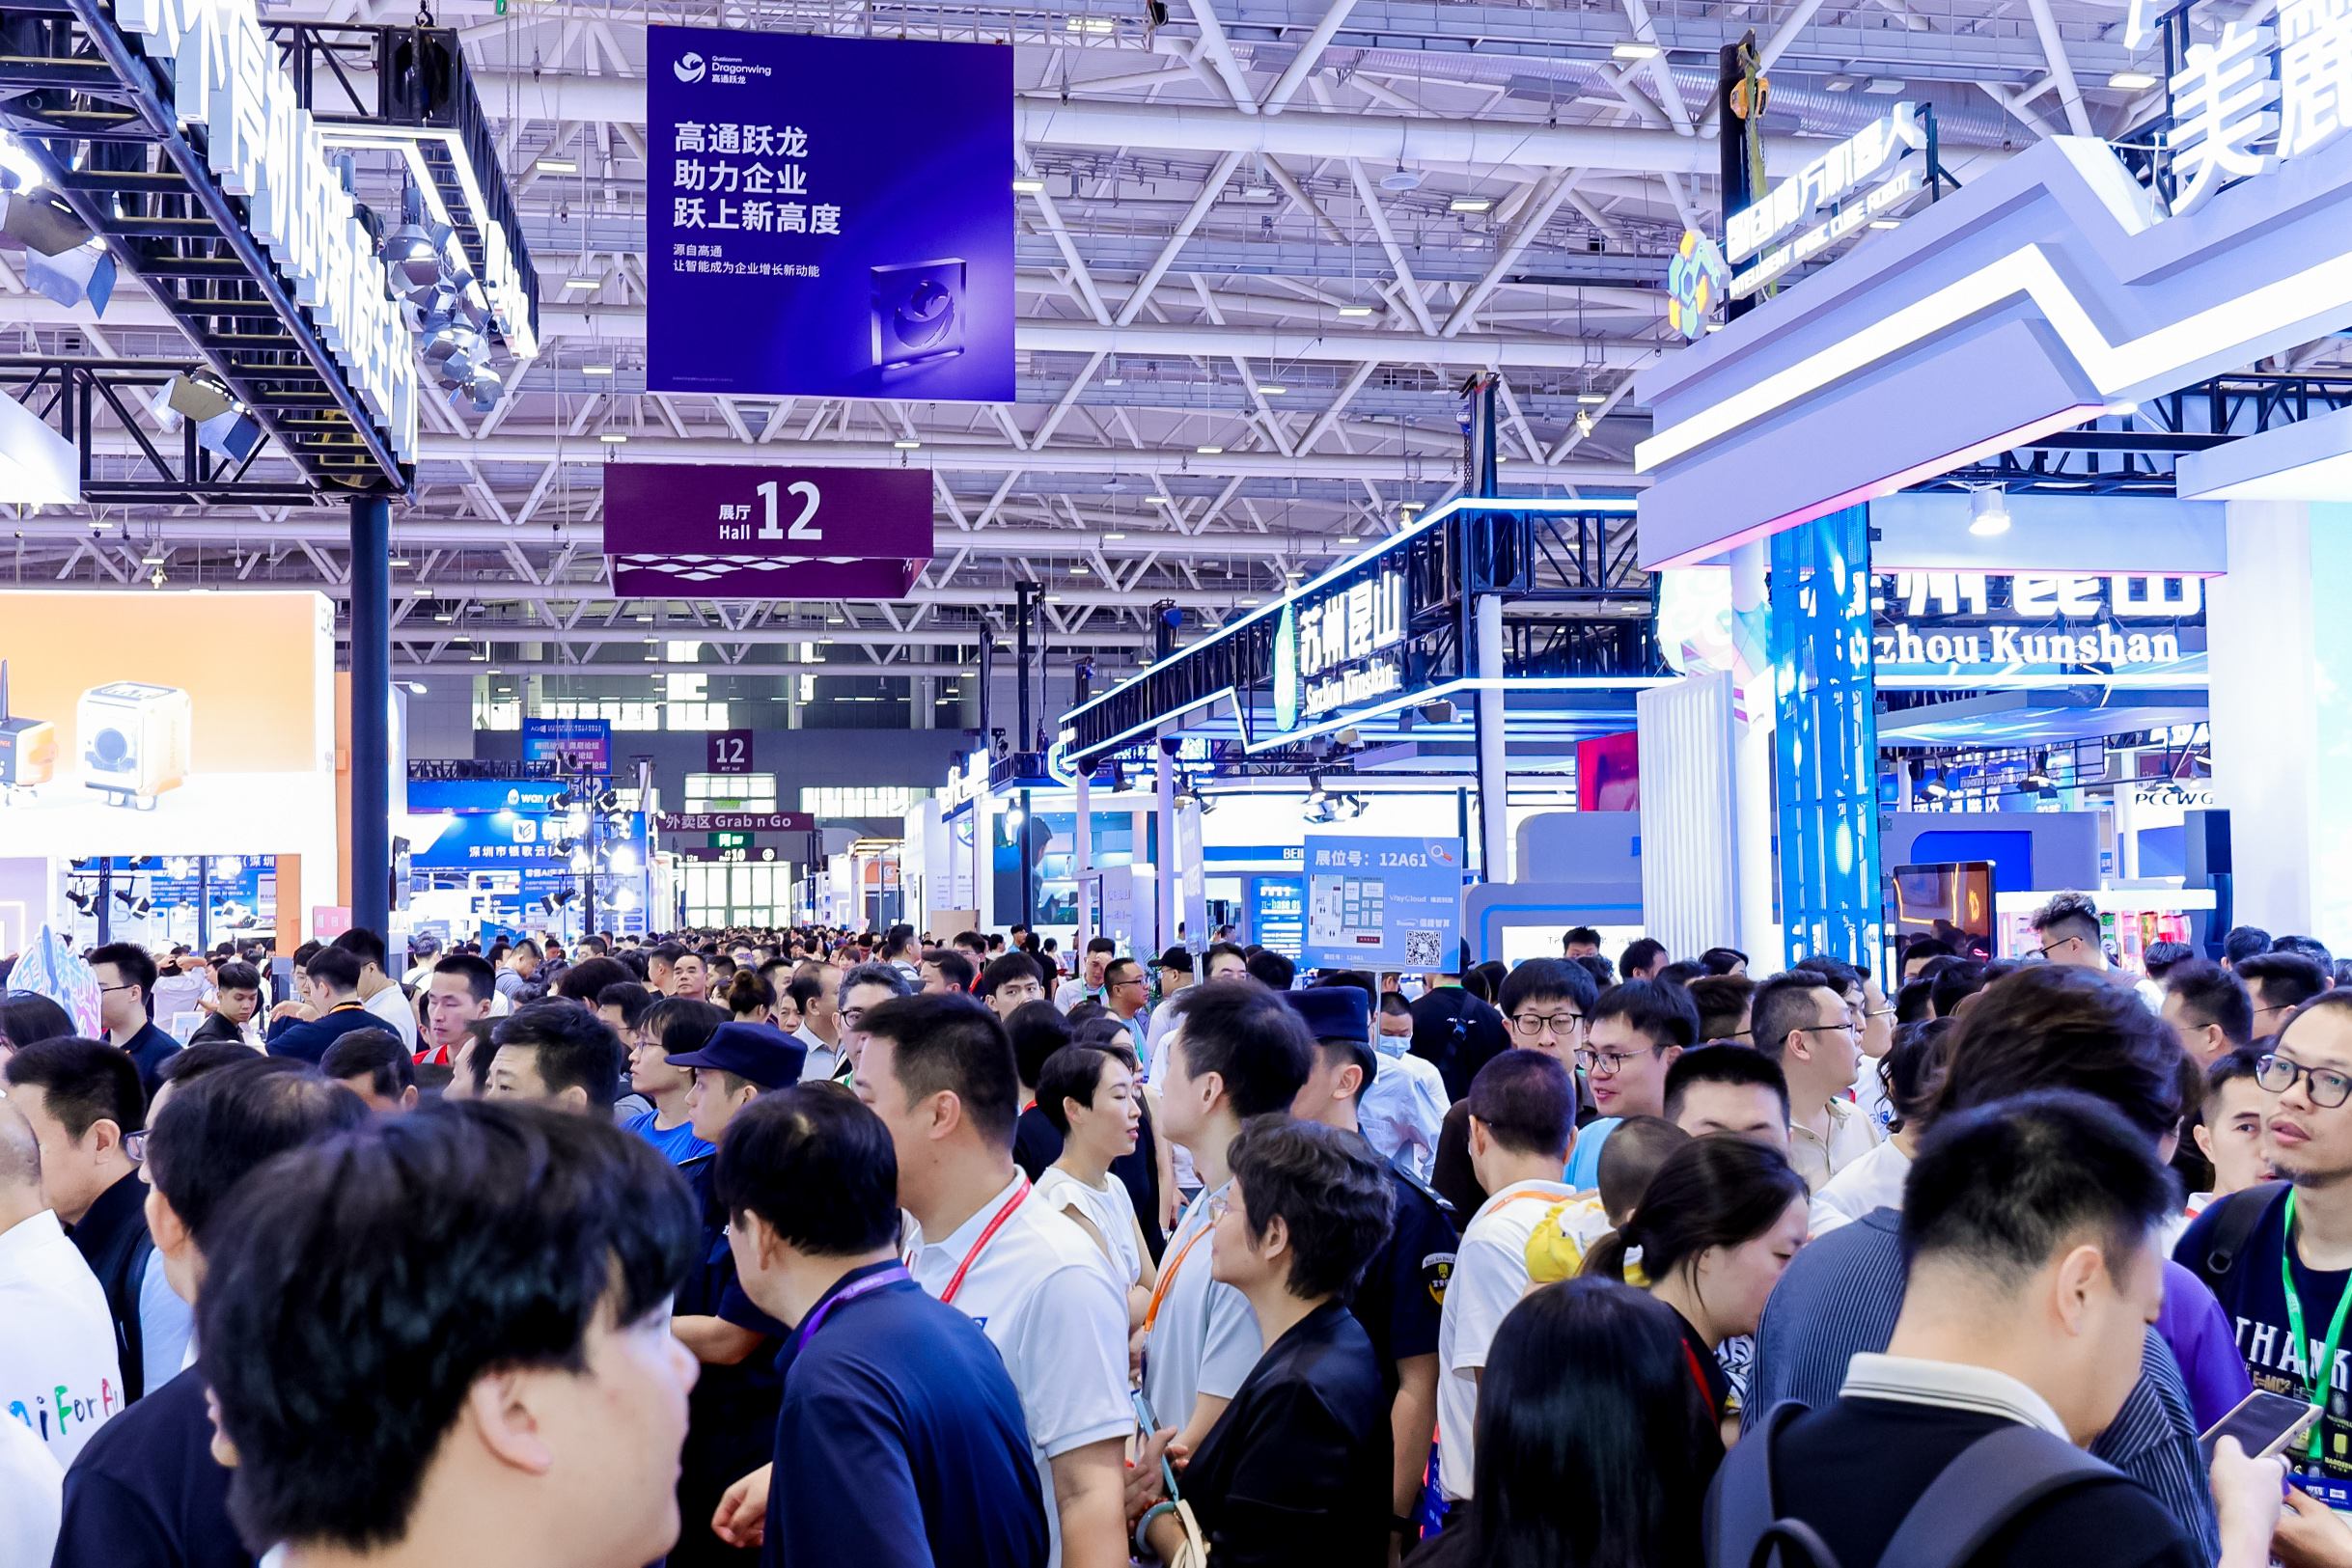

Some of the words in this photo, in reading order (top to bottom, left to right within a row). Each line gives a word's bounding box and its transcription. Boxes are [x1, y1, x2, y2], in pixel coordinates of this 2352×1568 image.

[711, 62, 772, 76] Dragonwing
[711, 73, 747, 85] 高通跃龙
[674, 121, 809, 157] 高通跃龙
[674, 159, 808, 195] 助力企业
[673, 198, 842, 235] 跃上新高度
[673, 243, 723, 258] 源自高通
[673, 260, 820, 278] 让智能成为企业增长新动能
[719, 505, 751, 521] 展厅
[757, 481, 822, 541] 12
[719, 524, 751, 540] Hall
[1300, 570, 1400, 676] 苏州昆山
[1988, 624, 2181, 666] Kunshan
[716, 738, 745, 763] 12
[2136, 792, 2198, 806] PCCW
[666, 814, 711, 829] 外卖区
[715, 814, 753, 828] Grab
[757, 818, 765, 827] n
[770, 814, 791, 827] Go
[732, 848, 746, 862] 10
